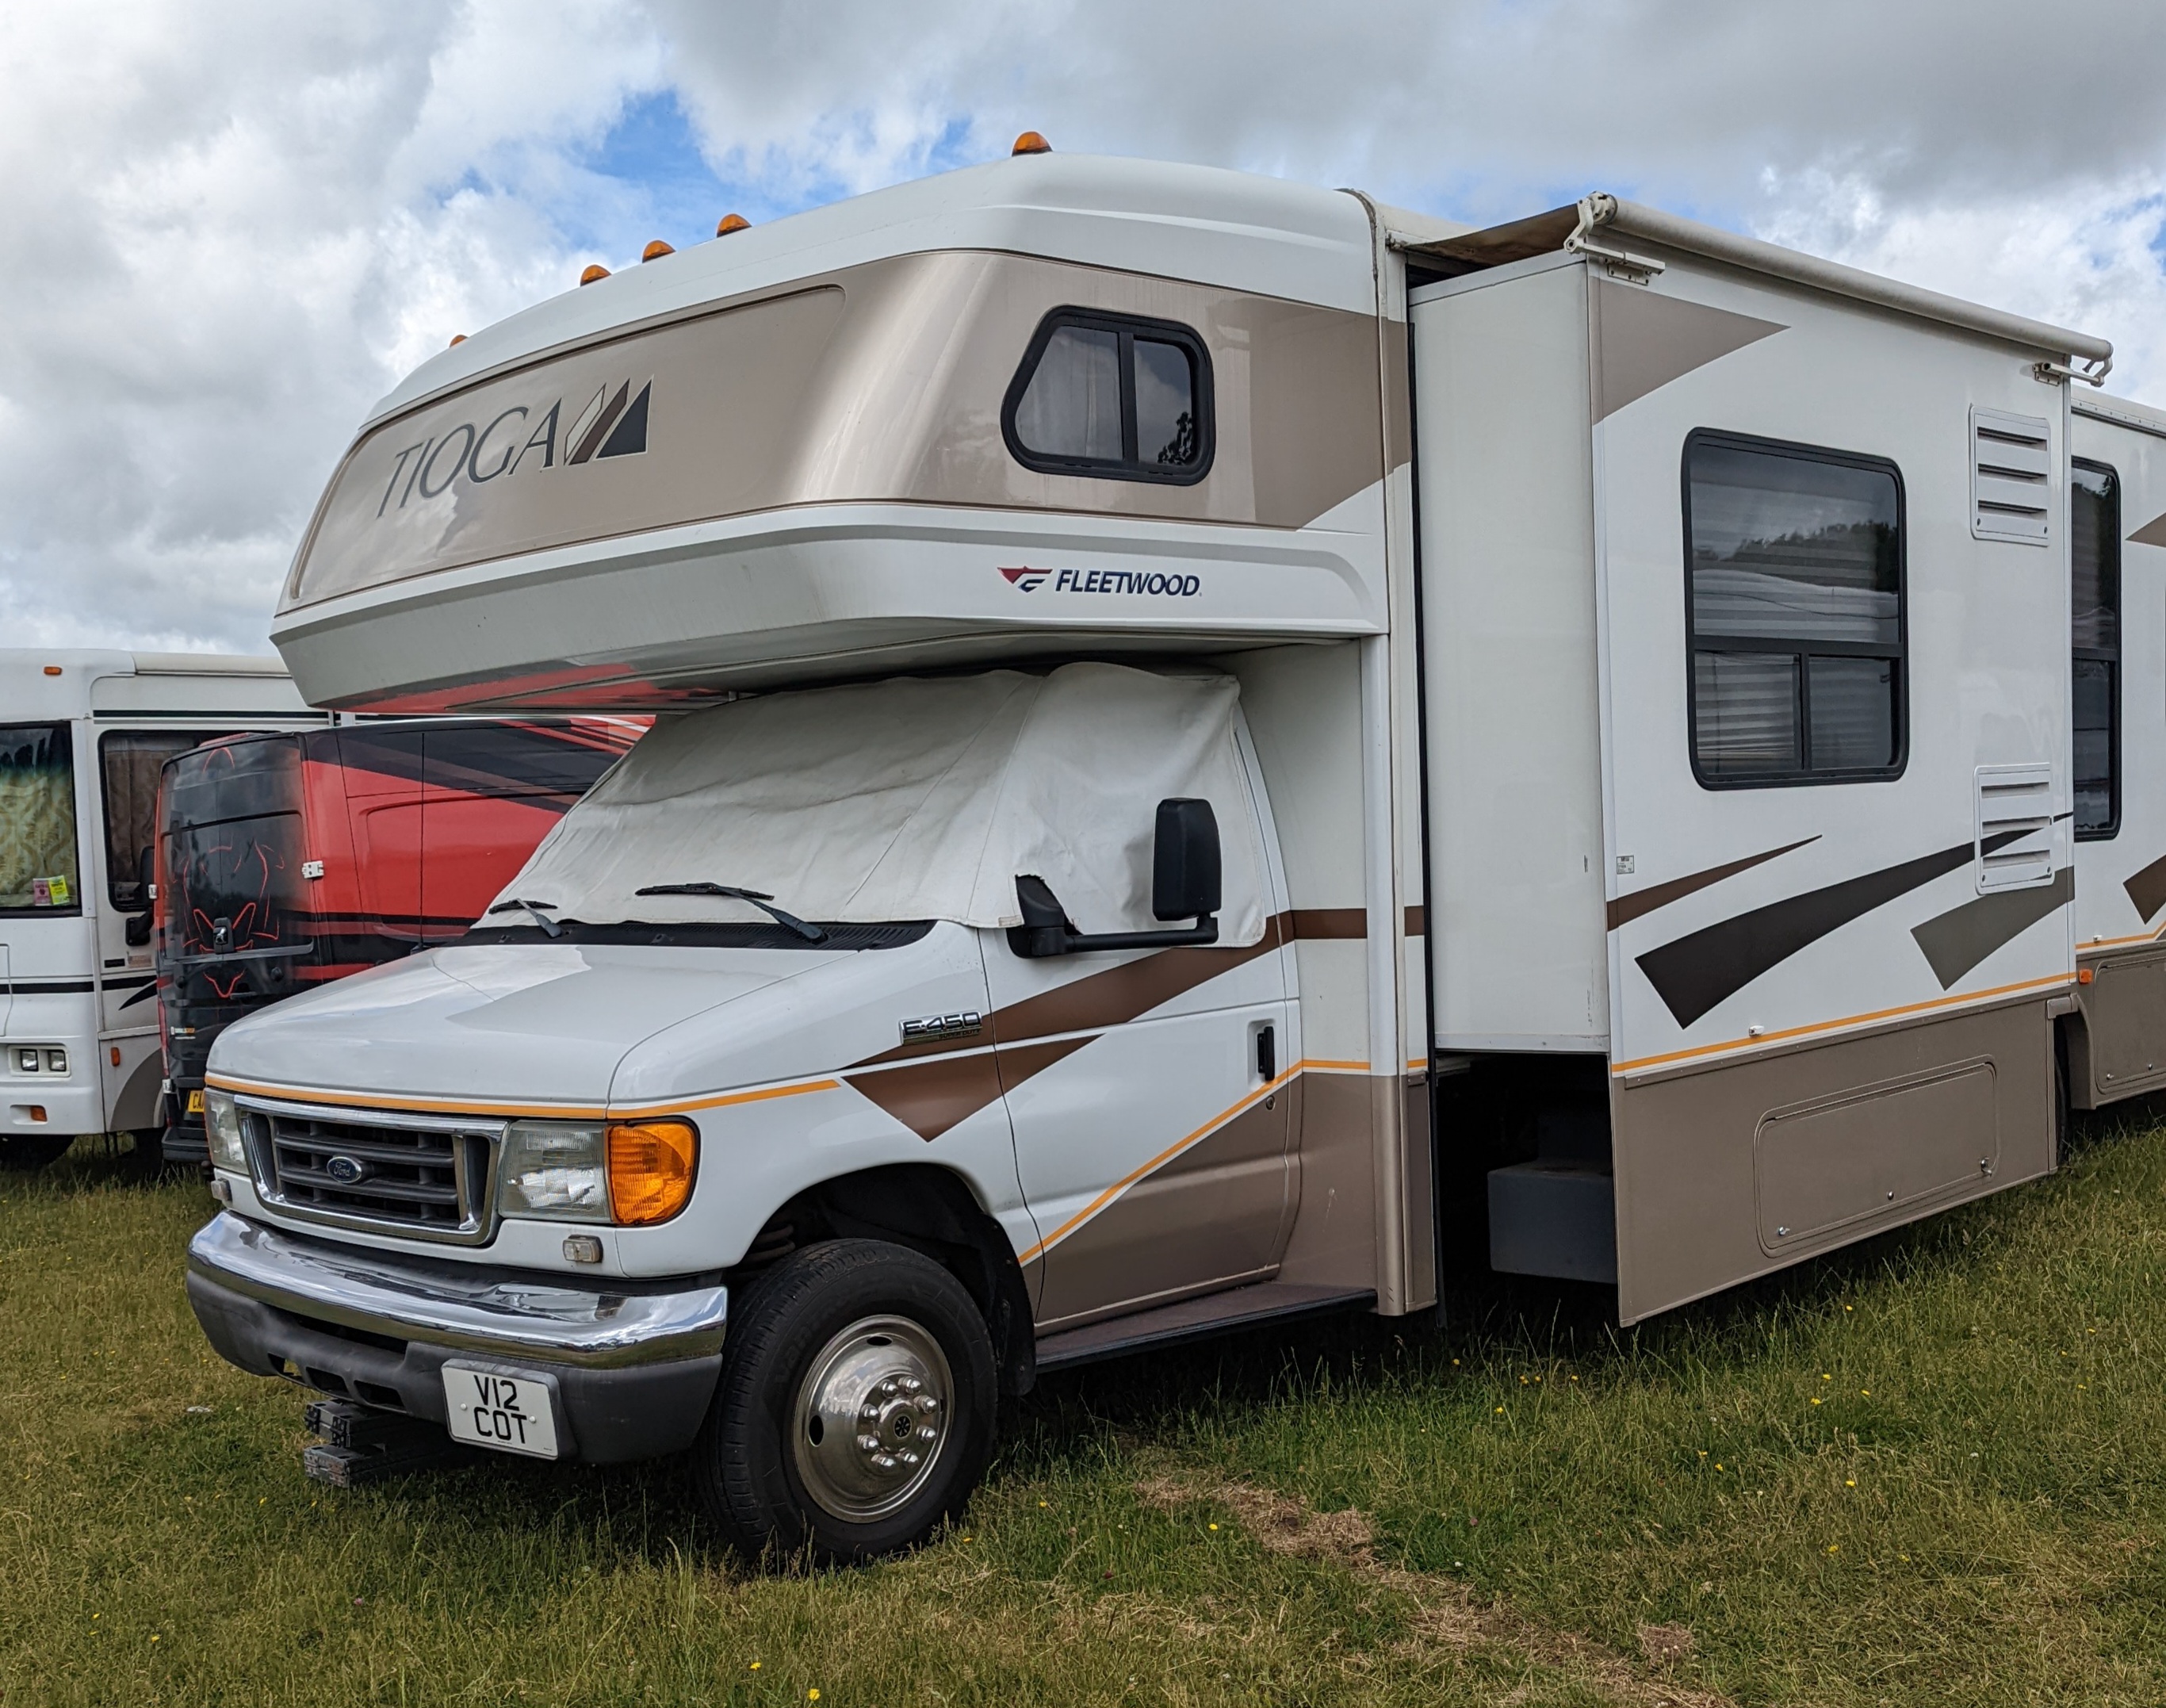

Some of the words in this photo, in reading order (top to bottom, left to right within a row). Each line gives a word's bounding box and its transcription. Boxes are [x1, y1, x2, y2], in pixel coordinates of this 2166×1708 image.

[376, 396, 563, 519] TIOGA
[1055, 569, 1200, 597] FLEETWOOD
[334, 1161, 351, 1177] Ford
[473, 1374, 520, 1411] V12
[474, 1407, 527, 1444] COT
